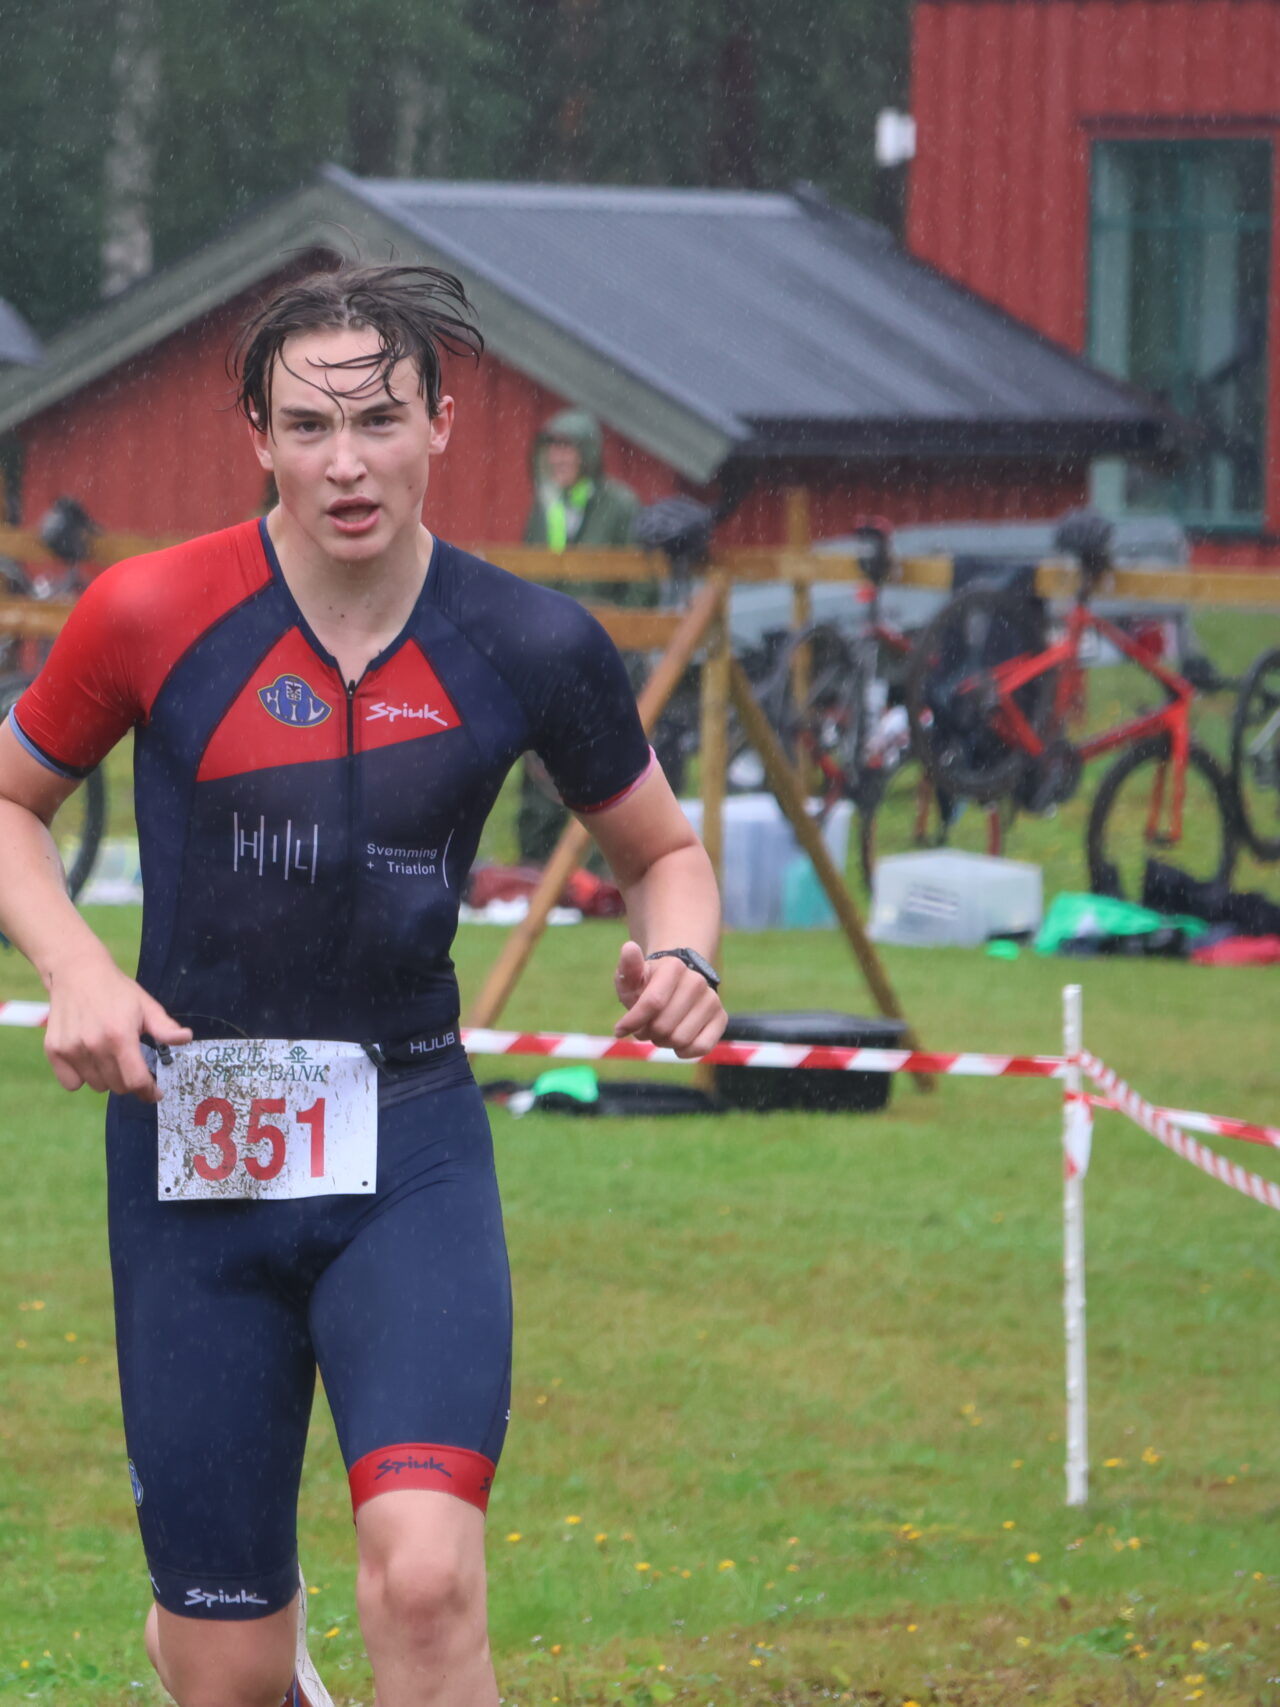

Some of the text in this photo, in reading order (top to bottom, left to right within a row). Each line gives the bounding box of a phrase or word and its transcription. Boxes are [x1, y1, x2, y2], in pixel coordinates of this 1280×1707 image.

[366, 702, 448, 727] Spiuk
[367, 843, 438, 860] Svømming
[386, 861, 436, 875] Triatlon
[410, 1031, 456, 1055] HUUB
[205, 1046, 267, 1064] GRUE
[193, 1097, 326, 1182] 351
[375, 1456, 452, 1480] Spiuk
[184, 1588, 268, 1607] Spiuk
